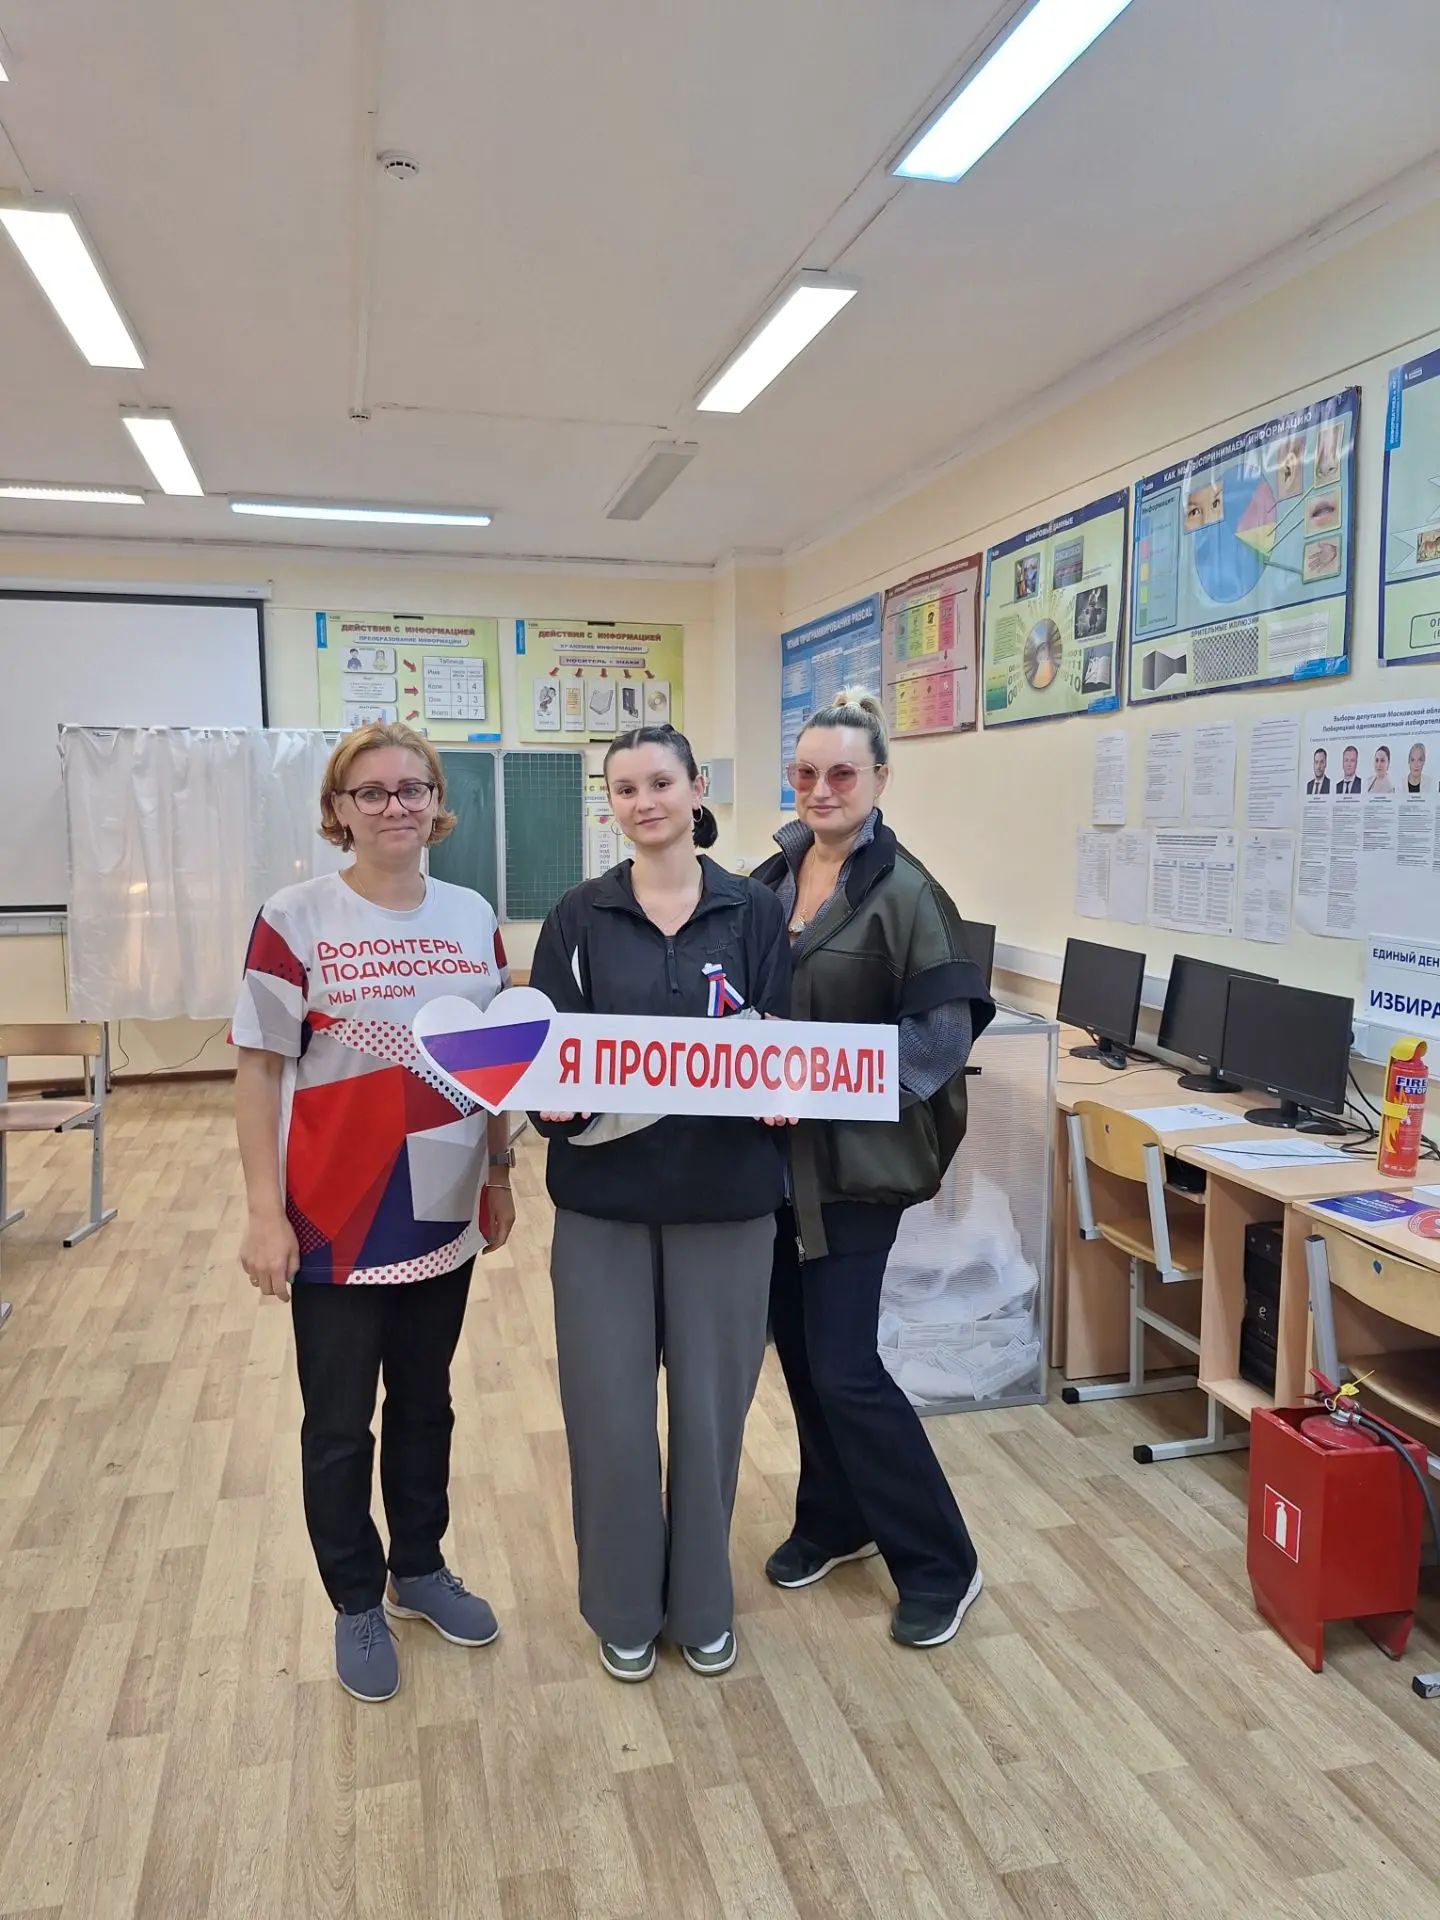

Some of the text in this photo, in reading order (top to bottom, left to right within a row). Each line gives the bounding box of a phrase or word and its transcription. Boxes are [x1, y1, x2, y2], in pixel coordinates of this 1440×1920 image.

[1163, 471, 1176, 483] КАК
[341, 623, 391, 633] ДЕЙСТВИЯ
[405, 626, 475, 636] ИНФОРМАЦИЕЙ
[359, 635, 462, 645] ПРЕОБРАЗОВАНИЕ ИНФОРМАЦИИ
[538, 631, 584, 639] ДЕЙСТВИЯ
[597, 632, 661, 642] ИНФОРМАЦИЕЙ
[1388, 708, 1425, 718] Московской
[317, 939, 463, 960] ВОЛОНТЕРЫ
[1373, 948, 1416, 964] ЕДИНЫЙ
[321, 958, 491, 985] ПОДМОСКОВЬЯ
[328, 985, 415, 1006] МЫ РЯДОМ
[559, 1038, 885, 1094] Я ПРОГОЛОСОВАЛ!
[1396, 1076, 1427, 1087] FIRE
